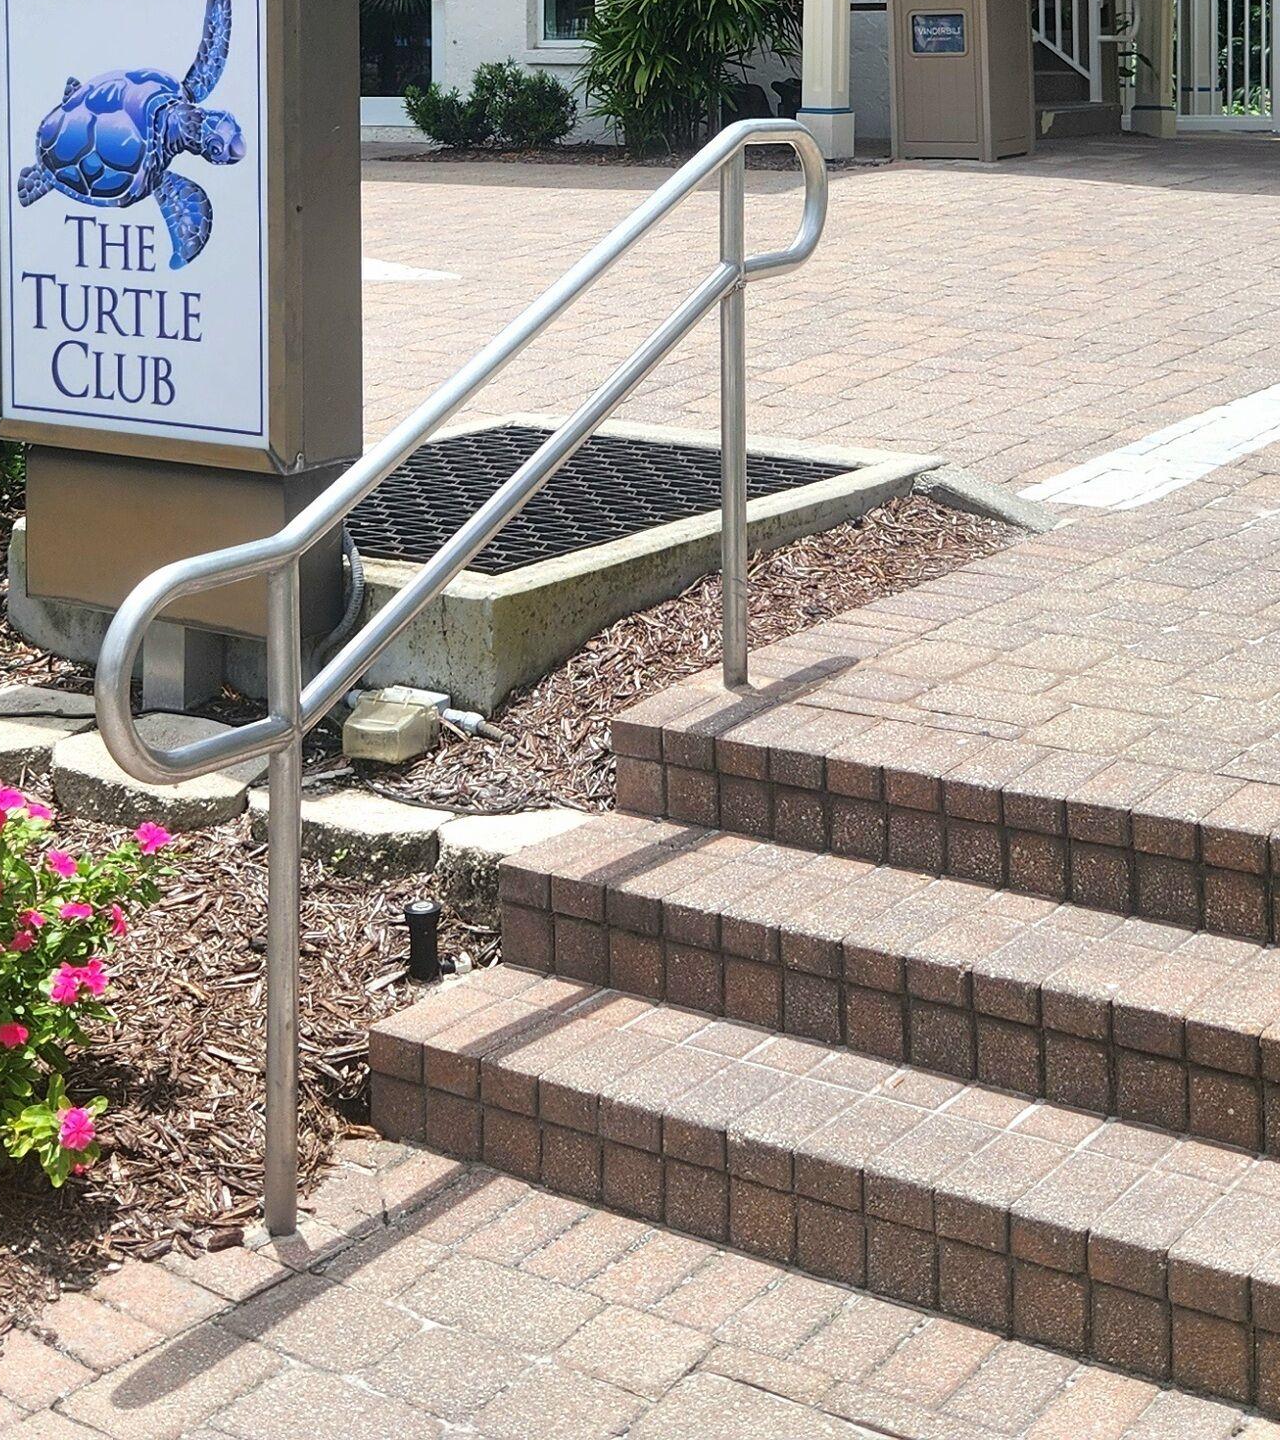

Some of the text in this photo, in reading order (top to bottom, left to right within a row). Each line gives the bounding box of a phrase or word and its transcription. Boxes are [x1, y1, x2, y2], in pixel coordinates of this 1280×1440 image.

[64, 215, 157, 272] THE
[21, 271, 203, 343] TURTLE
[51, 340, 176, 406] CLUB
